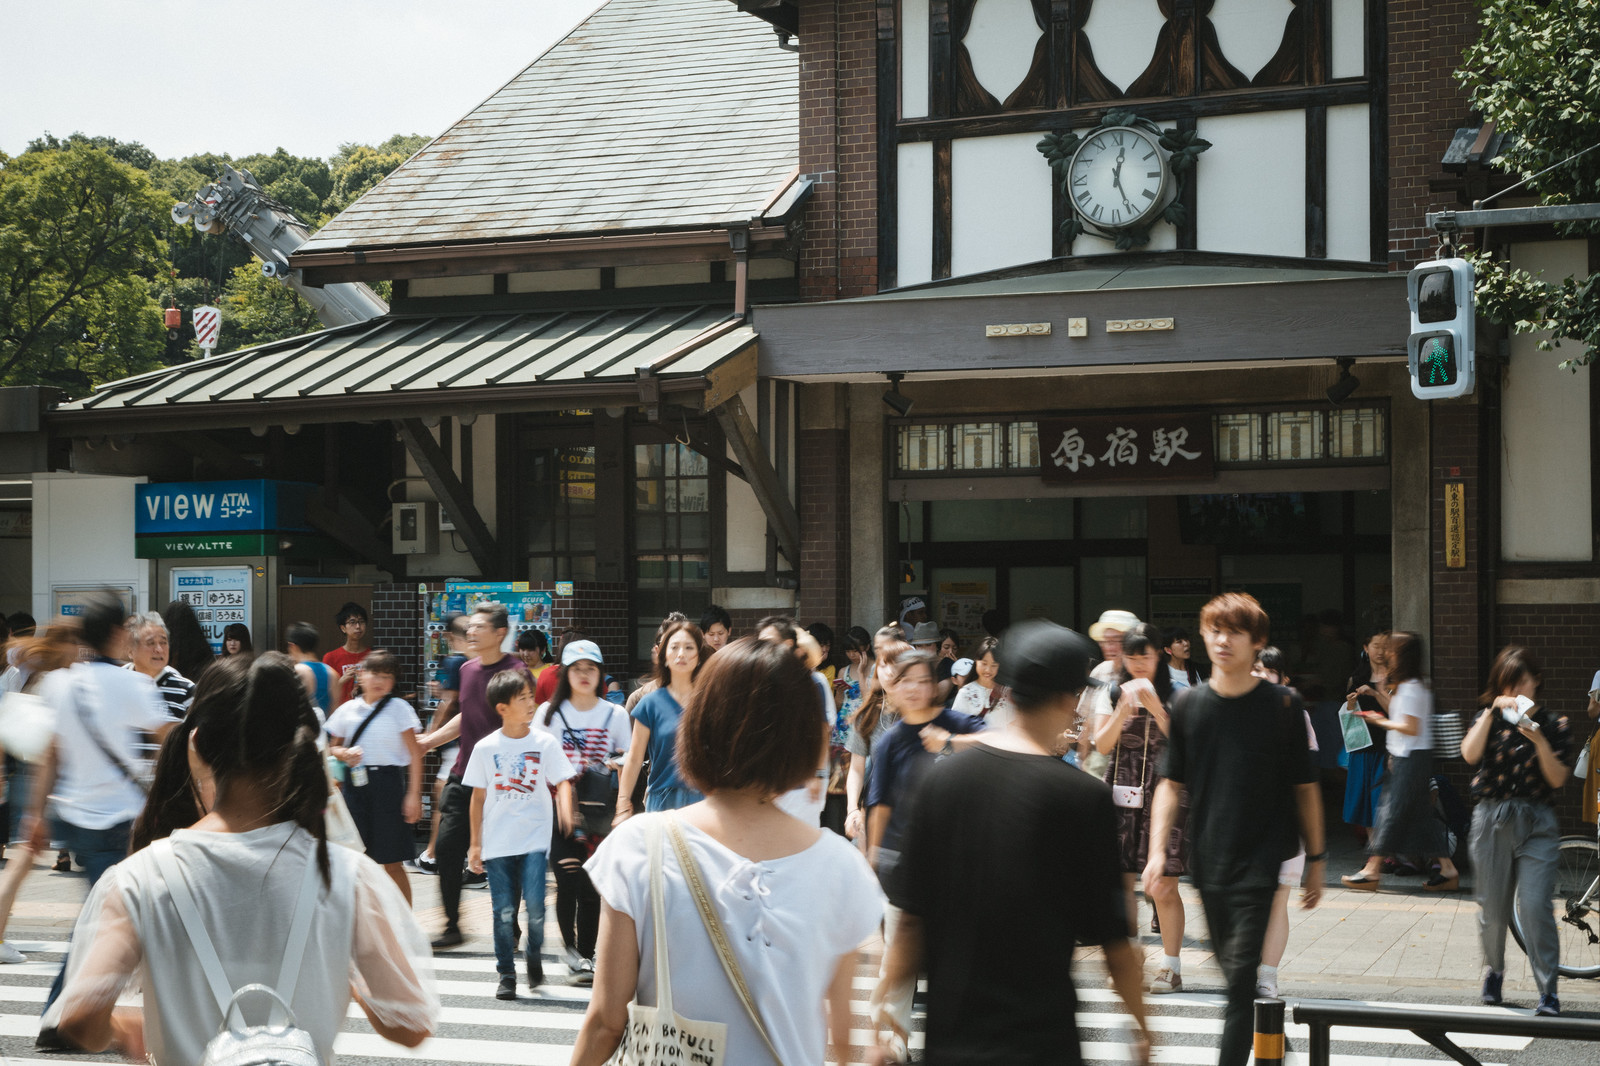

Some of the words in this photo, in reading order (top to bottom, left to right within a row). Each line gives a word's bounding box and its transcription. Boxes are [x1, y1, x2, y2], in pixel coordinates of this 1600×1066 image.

[1051, 427, 1202, 472] 原宿駅
[221, 493, 250, 507] ATM
[220, 507, 253, 518] コーナー
[165, 543, 195, 551] VIEW
[197, 541, 233, 550] ALTTE
[180, 593, 202, 605] 銀行
[209, 592, 242, 605] ゆうちょ
[522, 596, 545, 604] acure
[216, 611, 244, 620] ろうきん
